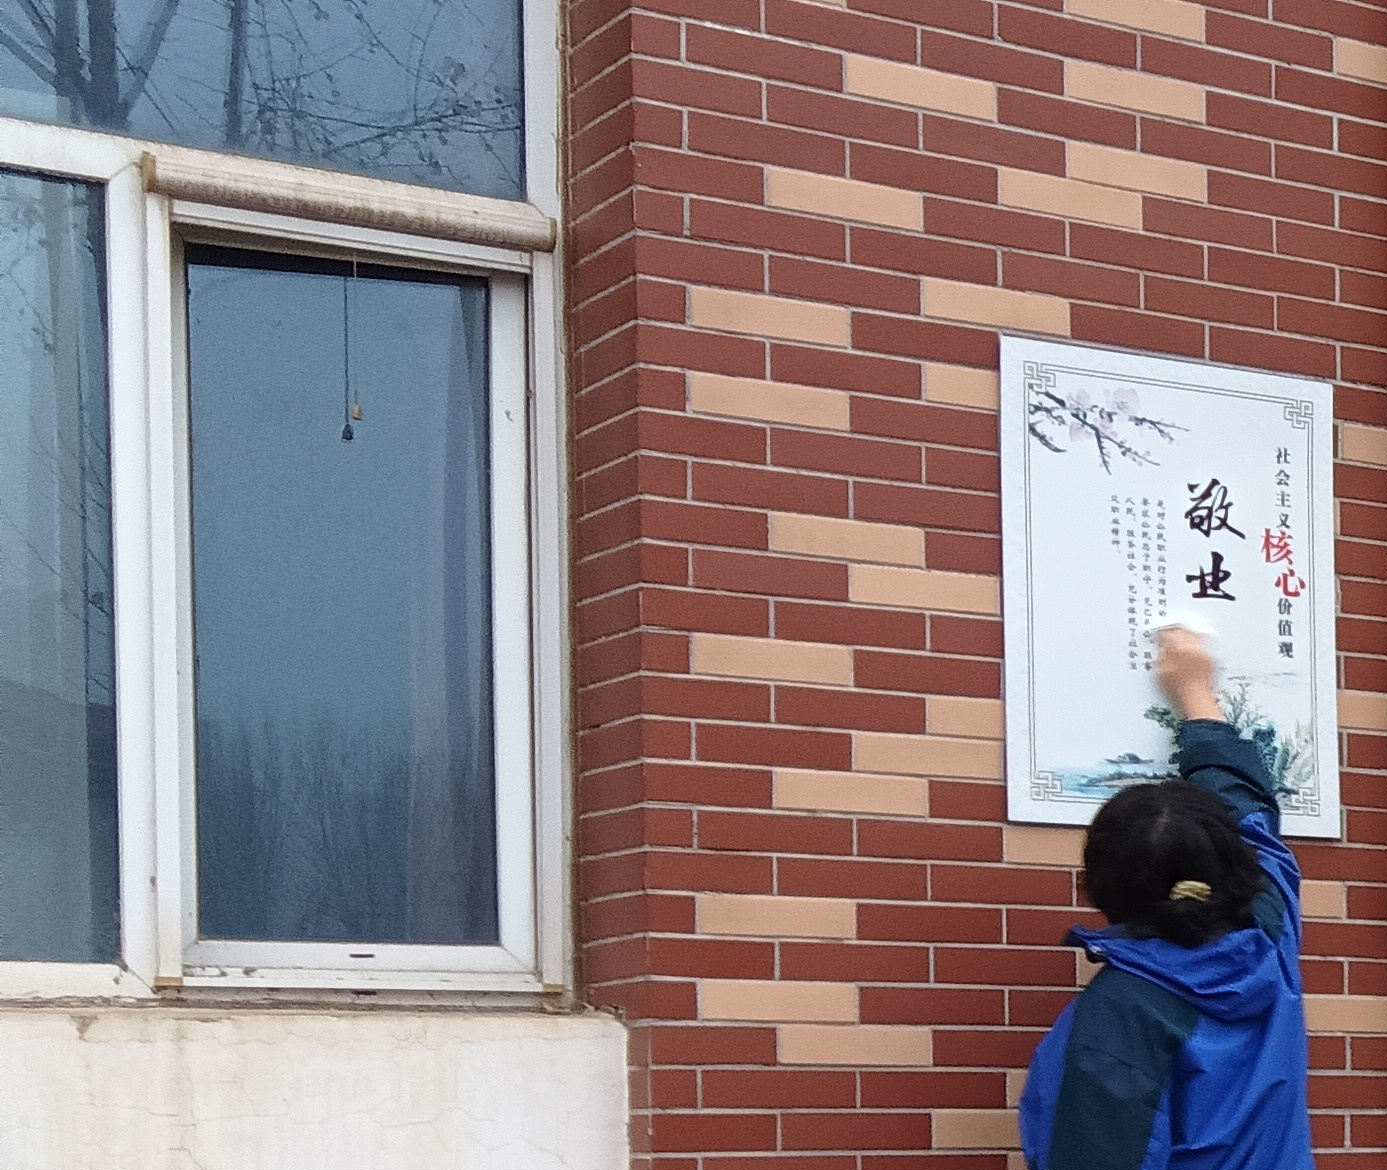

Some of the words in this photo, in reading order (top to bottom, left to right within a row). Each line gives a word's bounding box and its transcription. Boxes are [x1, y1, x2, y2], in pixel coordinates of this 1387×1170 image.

[1184, 478, 1246, 601] 敬业
[1261, 447, 1306, 659] 社会主义核心价值观
